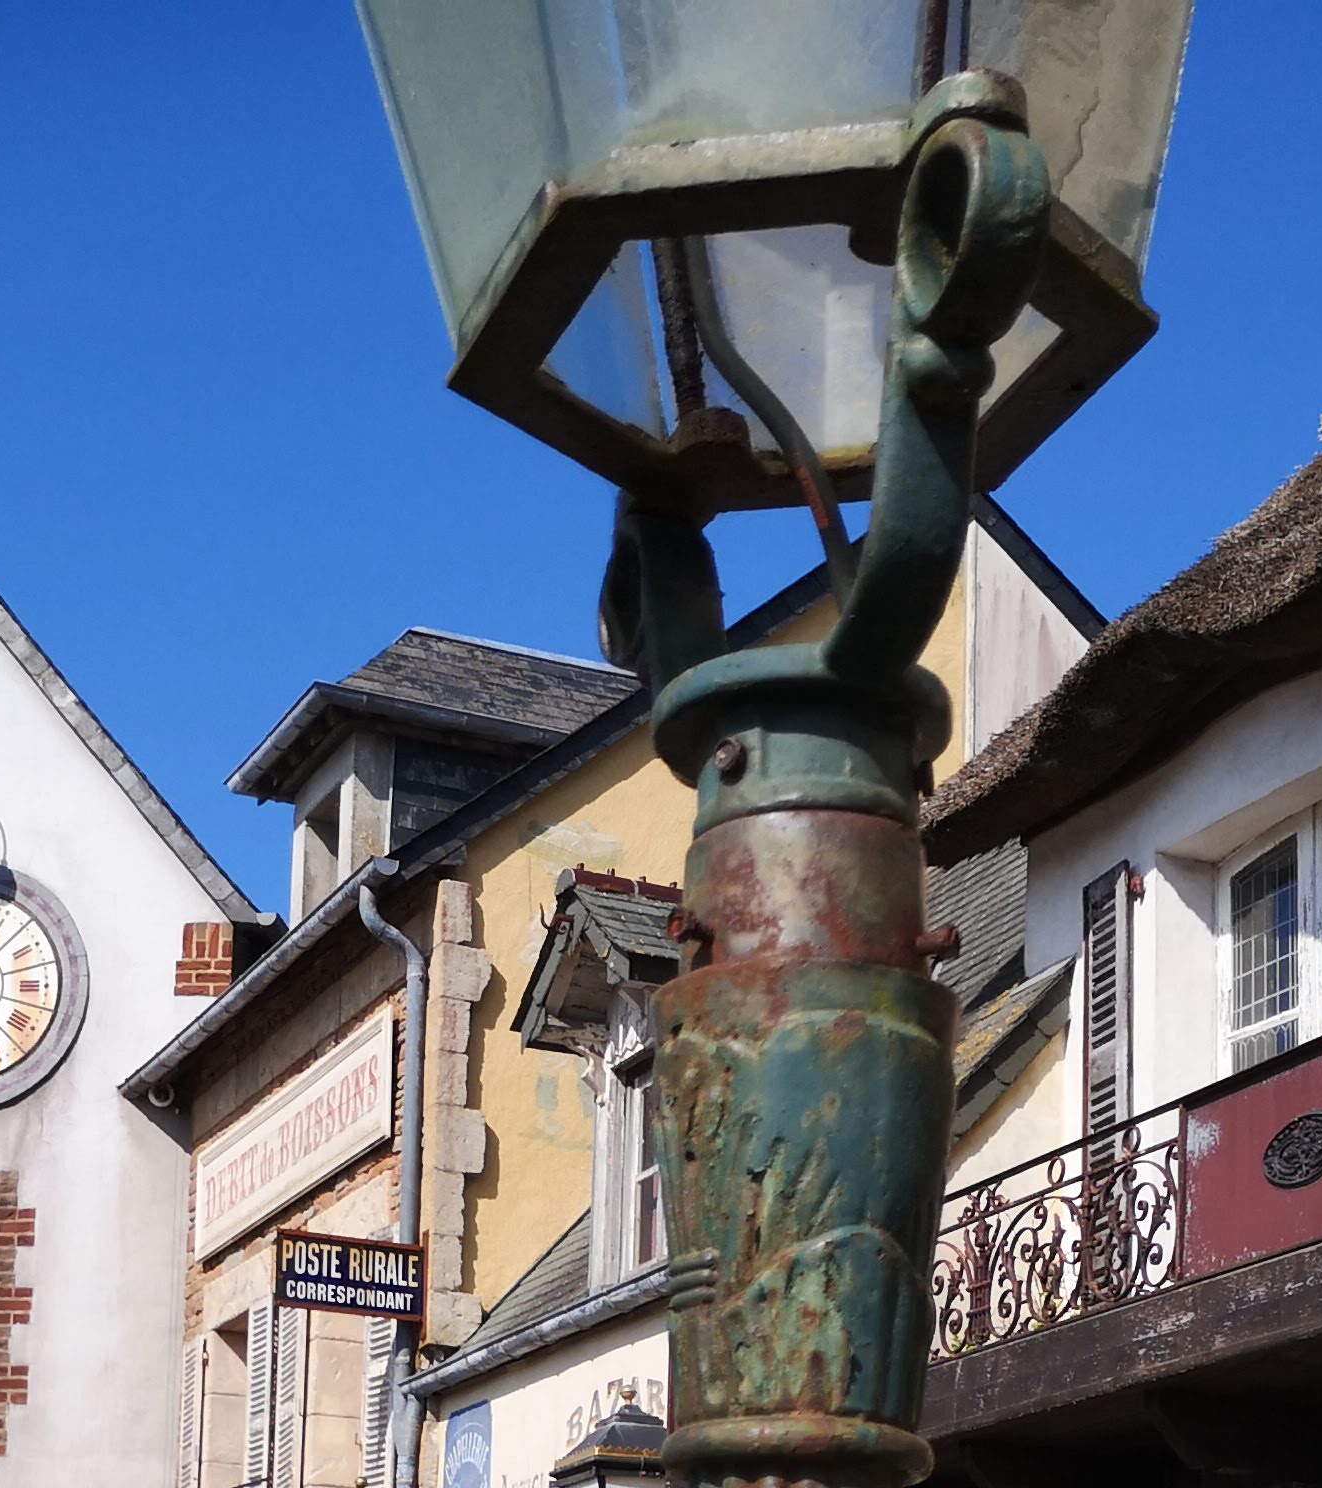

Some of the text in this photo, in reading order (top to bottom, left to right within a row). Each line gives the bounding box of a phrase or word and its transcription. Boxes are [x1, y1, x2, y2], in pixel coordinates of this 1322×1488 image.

[204, 1054, 380, 1222] DEBIT de BOISSONS
[282, 1239, 419, 1288] POSTE RURALE
[286, 1279, 414, 1312] CORRESPONDANT
